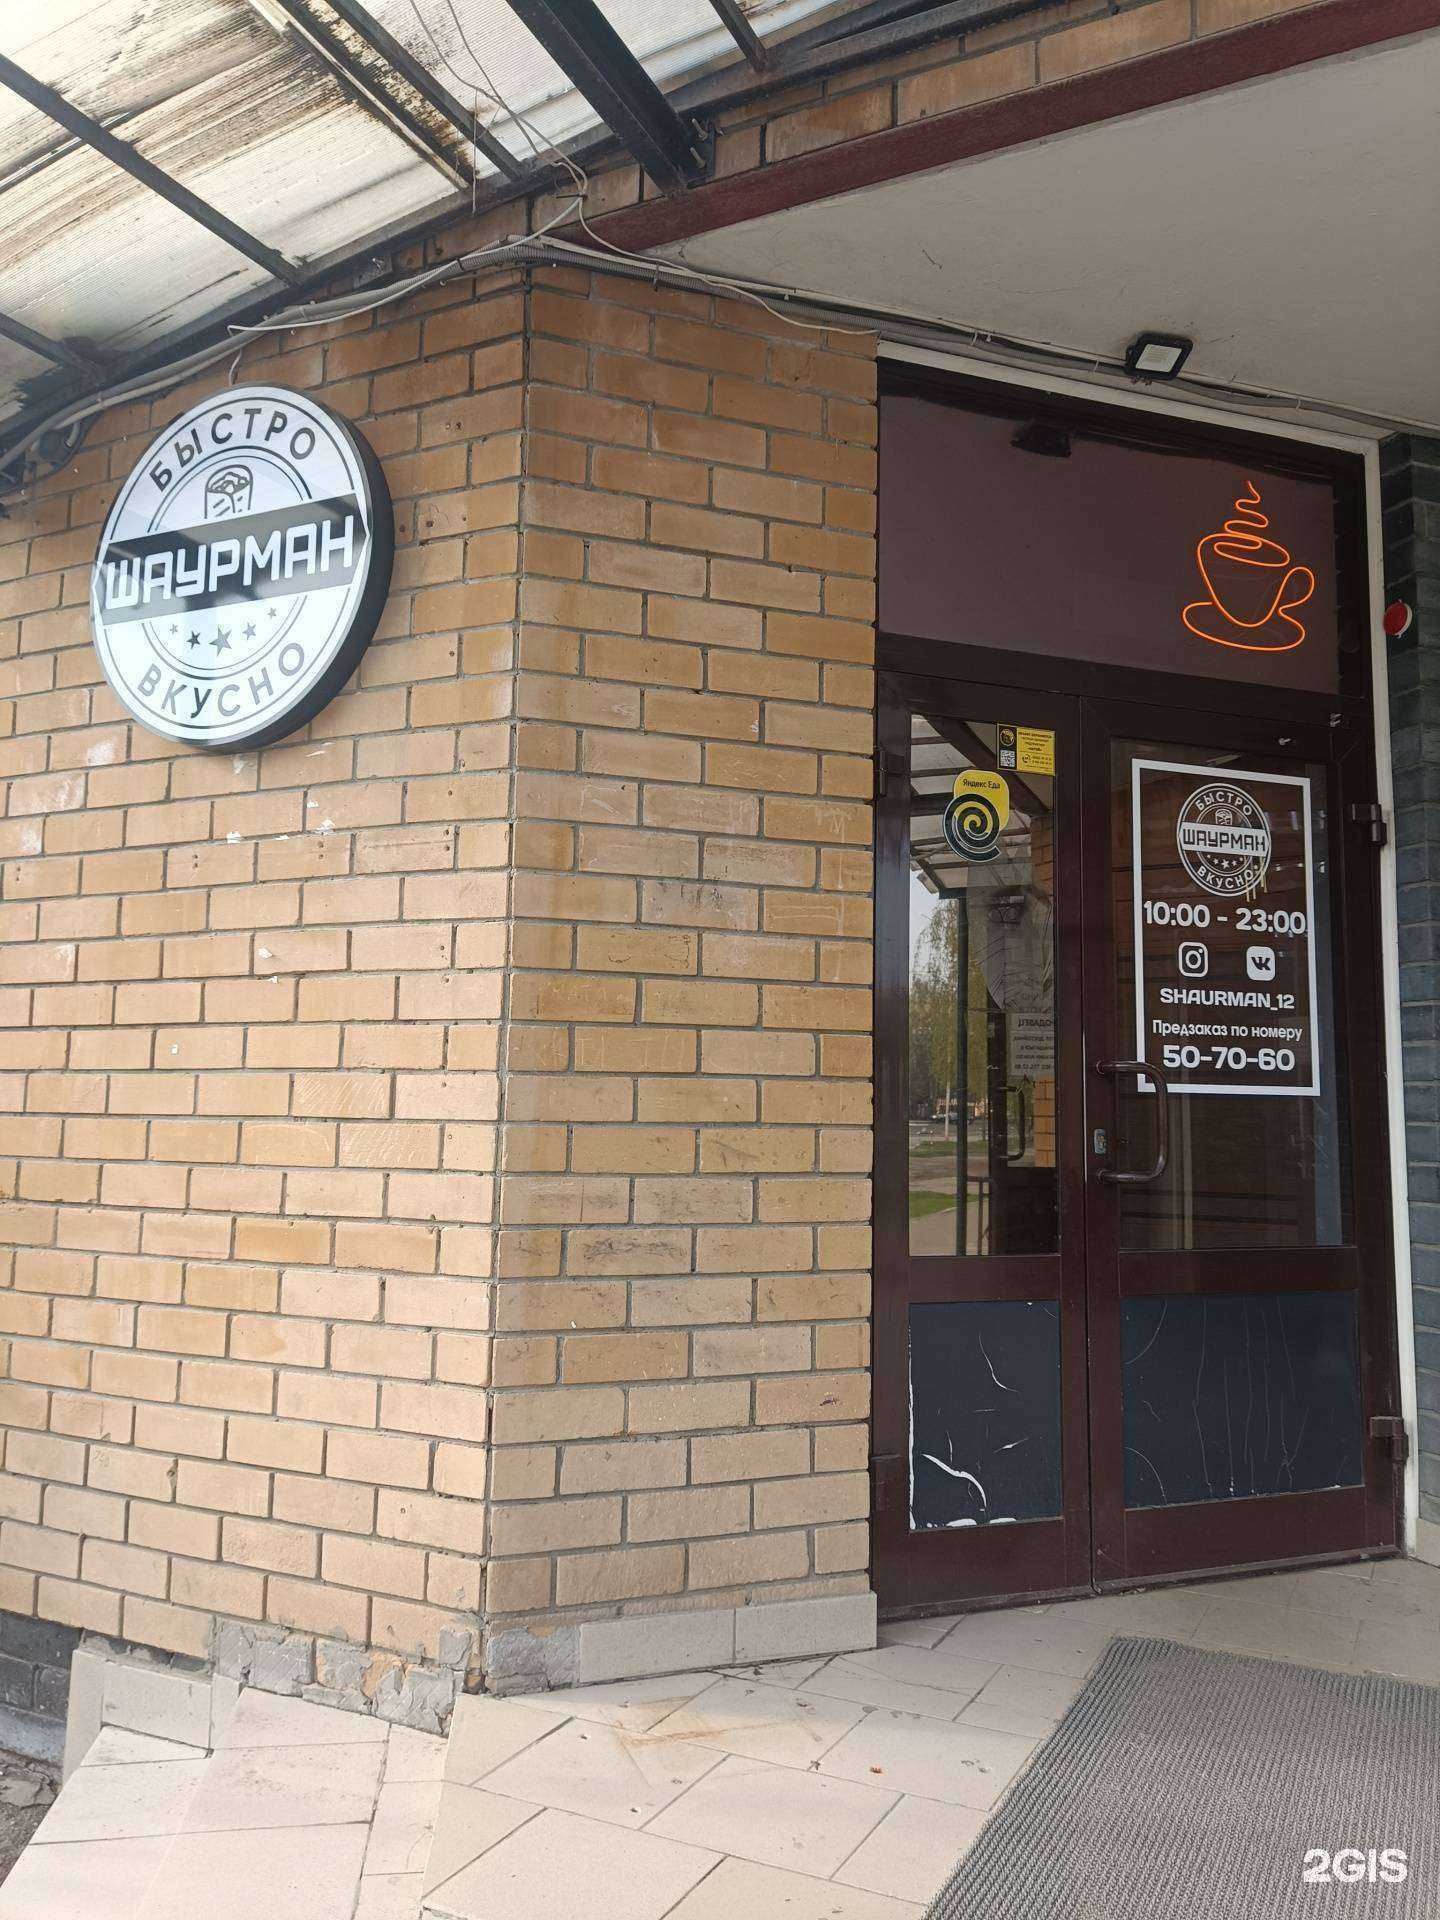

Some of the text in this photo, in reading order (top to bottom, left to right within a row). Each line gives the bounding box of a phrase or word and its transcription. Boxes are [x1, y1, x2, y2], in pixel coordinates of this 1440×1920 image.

[149, 408, 317, 492] БЫСТРО
[105, 515, 355, 609] ШАУРМАН
[137, 642, 305, 719] ВКУСНО
[963, 778, 1001, 789] Яндекс Еда
[1195, 791, 1252, 816] БЫСТРО
[1183, 828, 1266, 852] ШАУРМАН
[1197, 865, 1254, 889] ВКУСНО
[1143, 901, 1211, 928] 10:00
[1235, 907, 1306, 935] 23:00
[1160, 987, 1295, 1011] SHAURMAN_12
[1152, 1019, 1303, 1042] Предзаказ по номеру
[1163, 1045, 1295, 1071] 50-70-60
